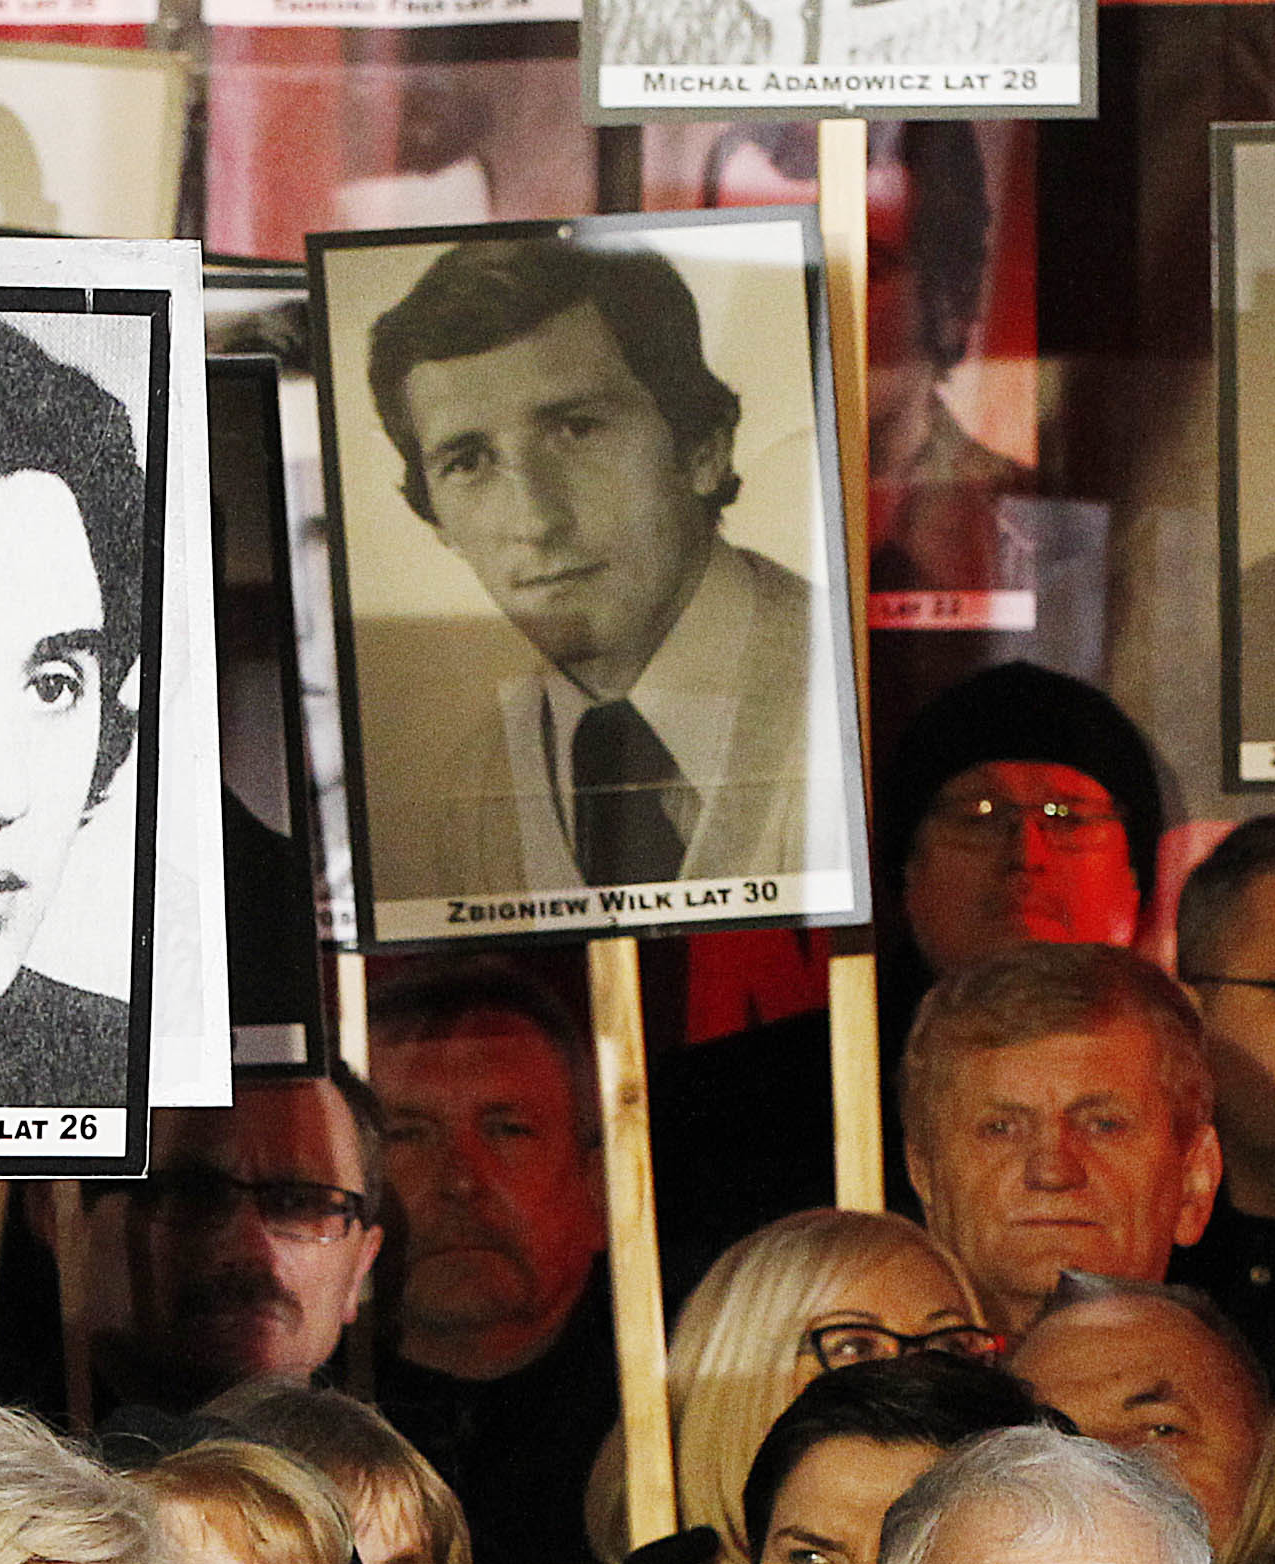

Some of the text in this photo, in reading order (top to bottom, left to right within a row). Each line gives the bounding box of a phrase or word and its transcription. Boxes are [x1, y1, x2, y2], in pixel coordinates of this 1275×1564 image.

[643, 69, 1039, 93] MICHAŁ ADAMOWICZ LAT 28
[447, 880, 779, 925] ZBIGNIEW WILK LAT 30
[59, 1113, 99, 1141] 26
